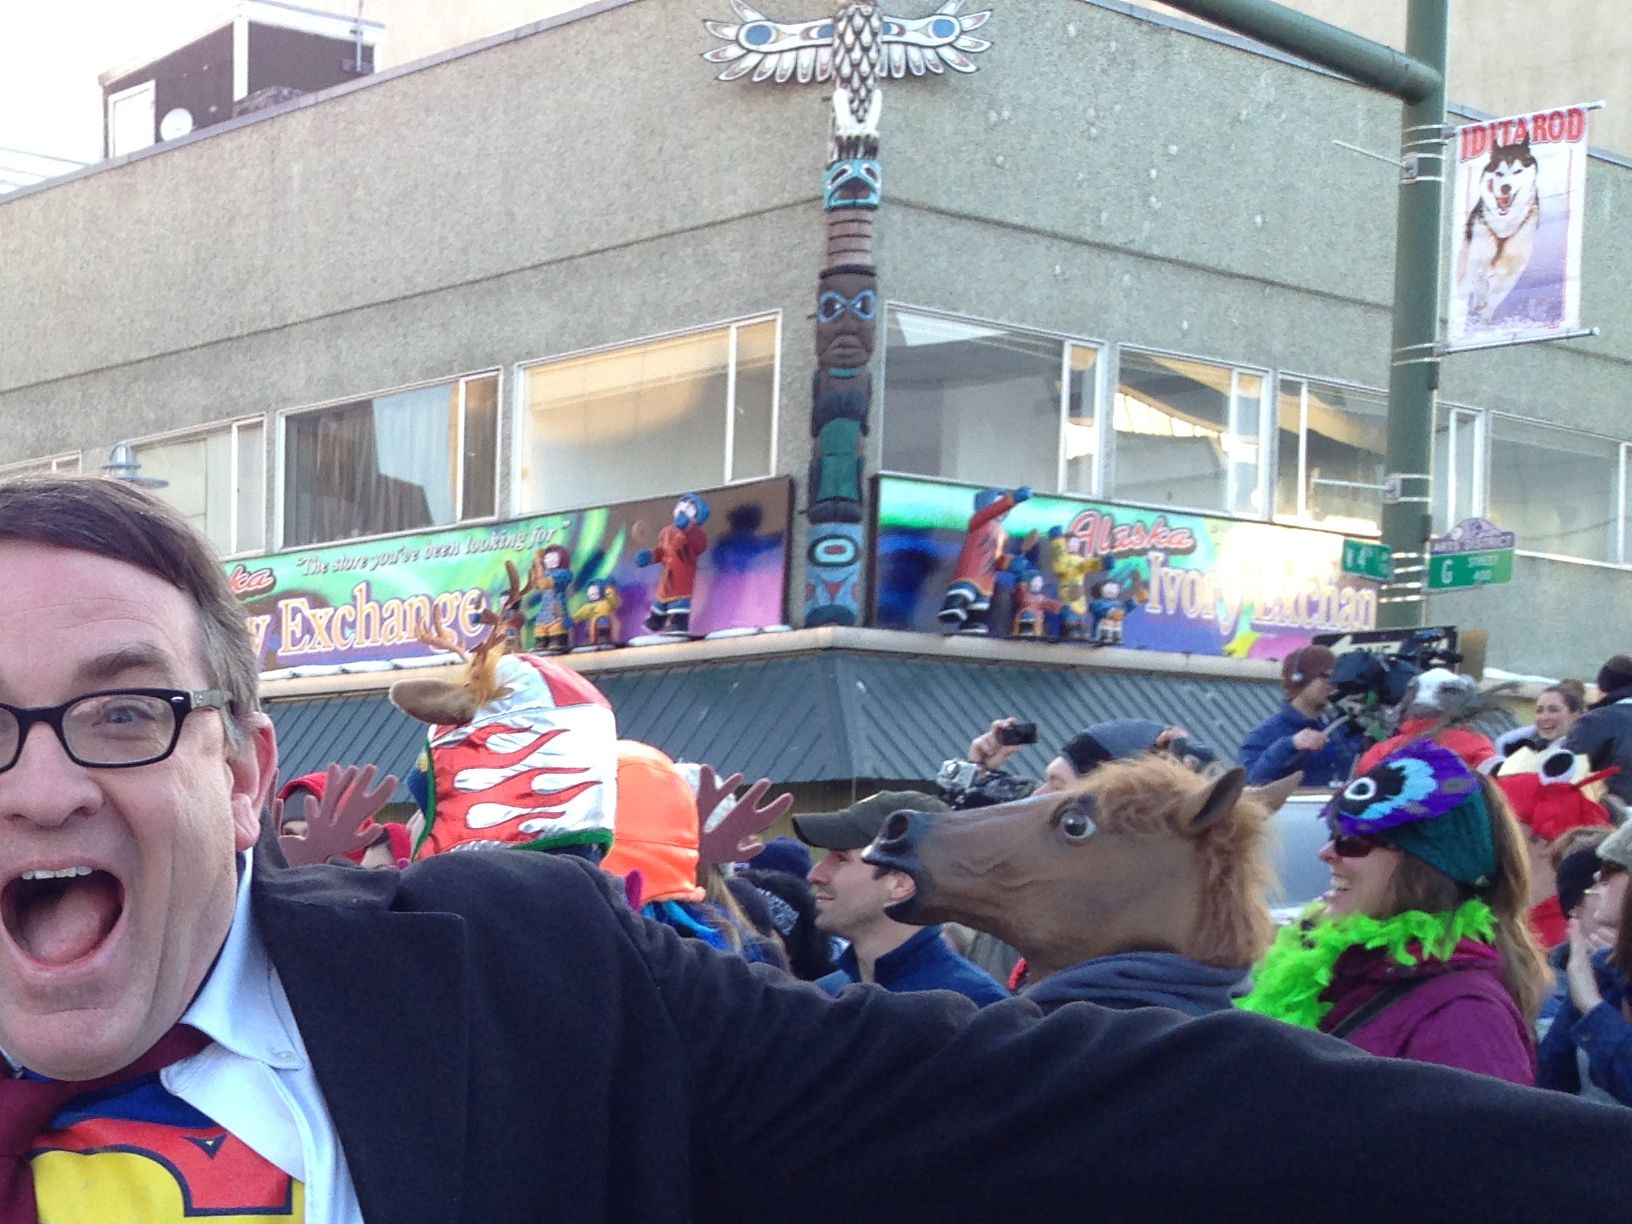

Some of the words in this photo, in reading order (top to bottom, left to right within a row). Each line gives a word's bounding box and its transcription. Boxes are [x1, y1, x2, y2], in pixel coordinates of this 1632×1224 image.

[332, 554, 368, 573] store
[424, 541, 460, 560] been
[466, 530, 528, 554] looking
[1068, 511, 1196, 557] Alaska
[277, 580, 487, 656] Exchange
[1145, 551, 1242, 636] Ivory
